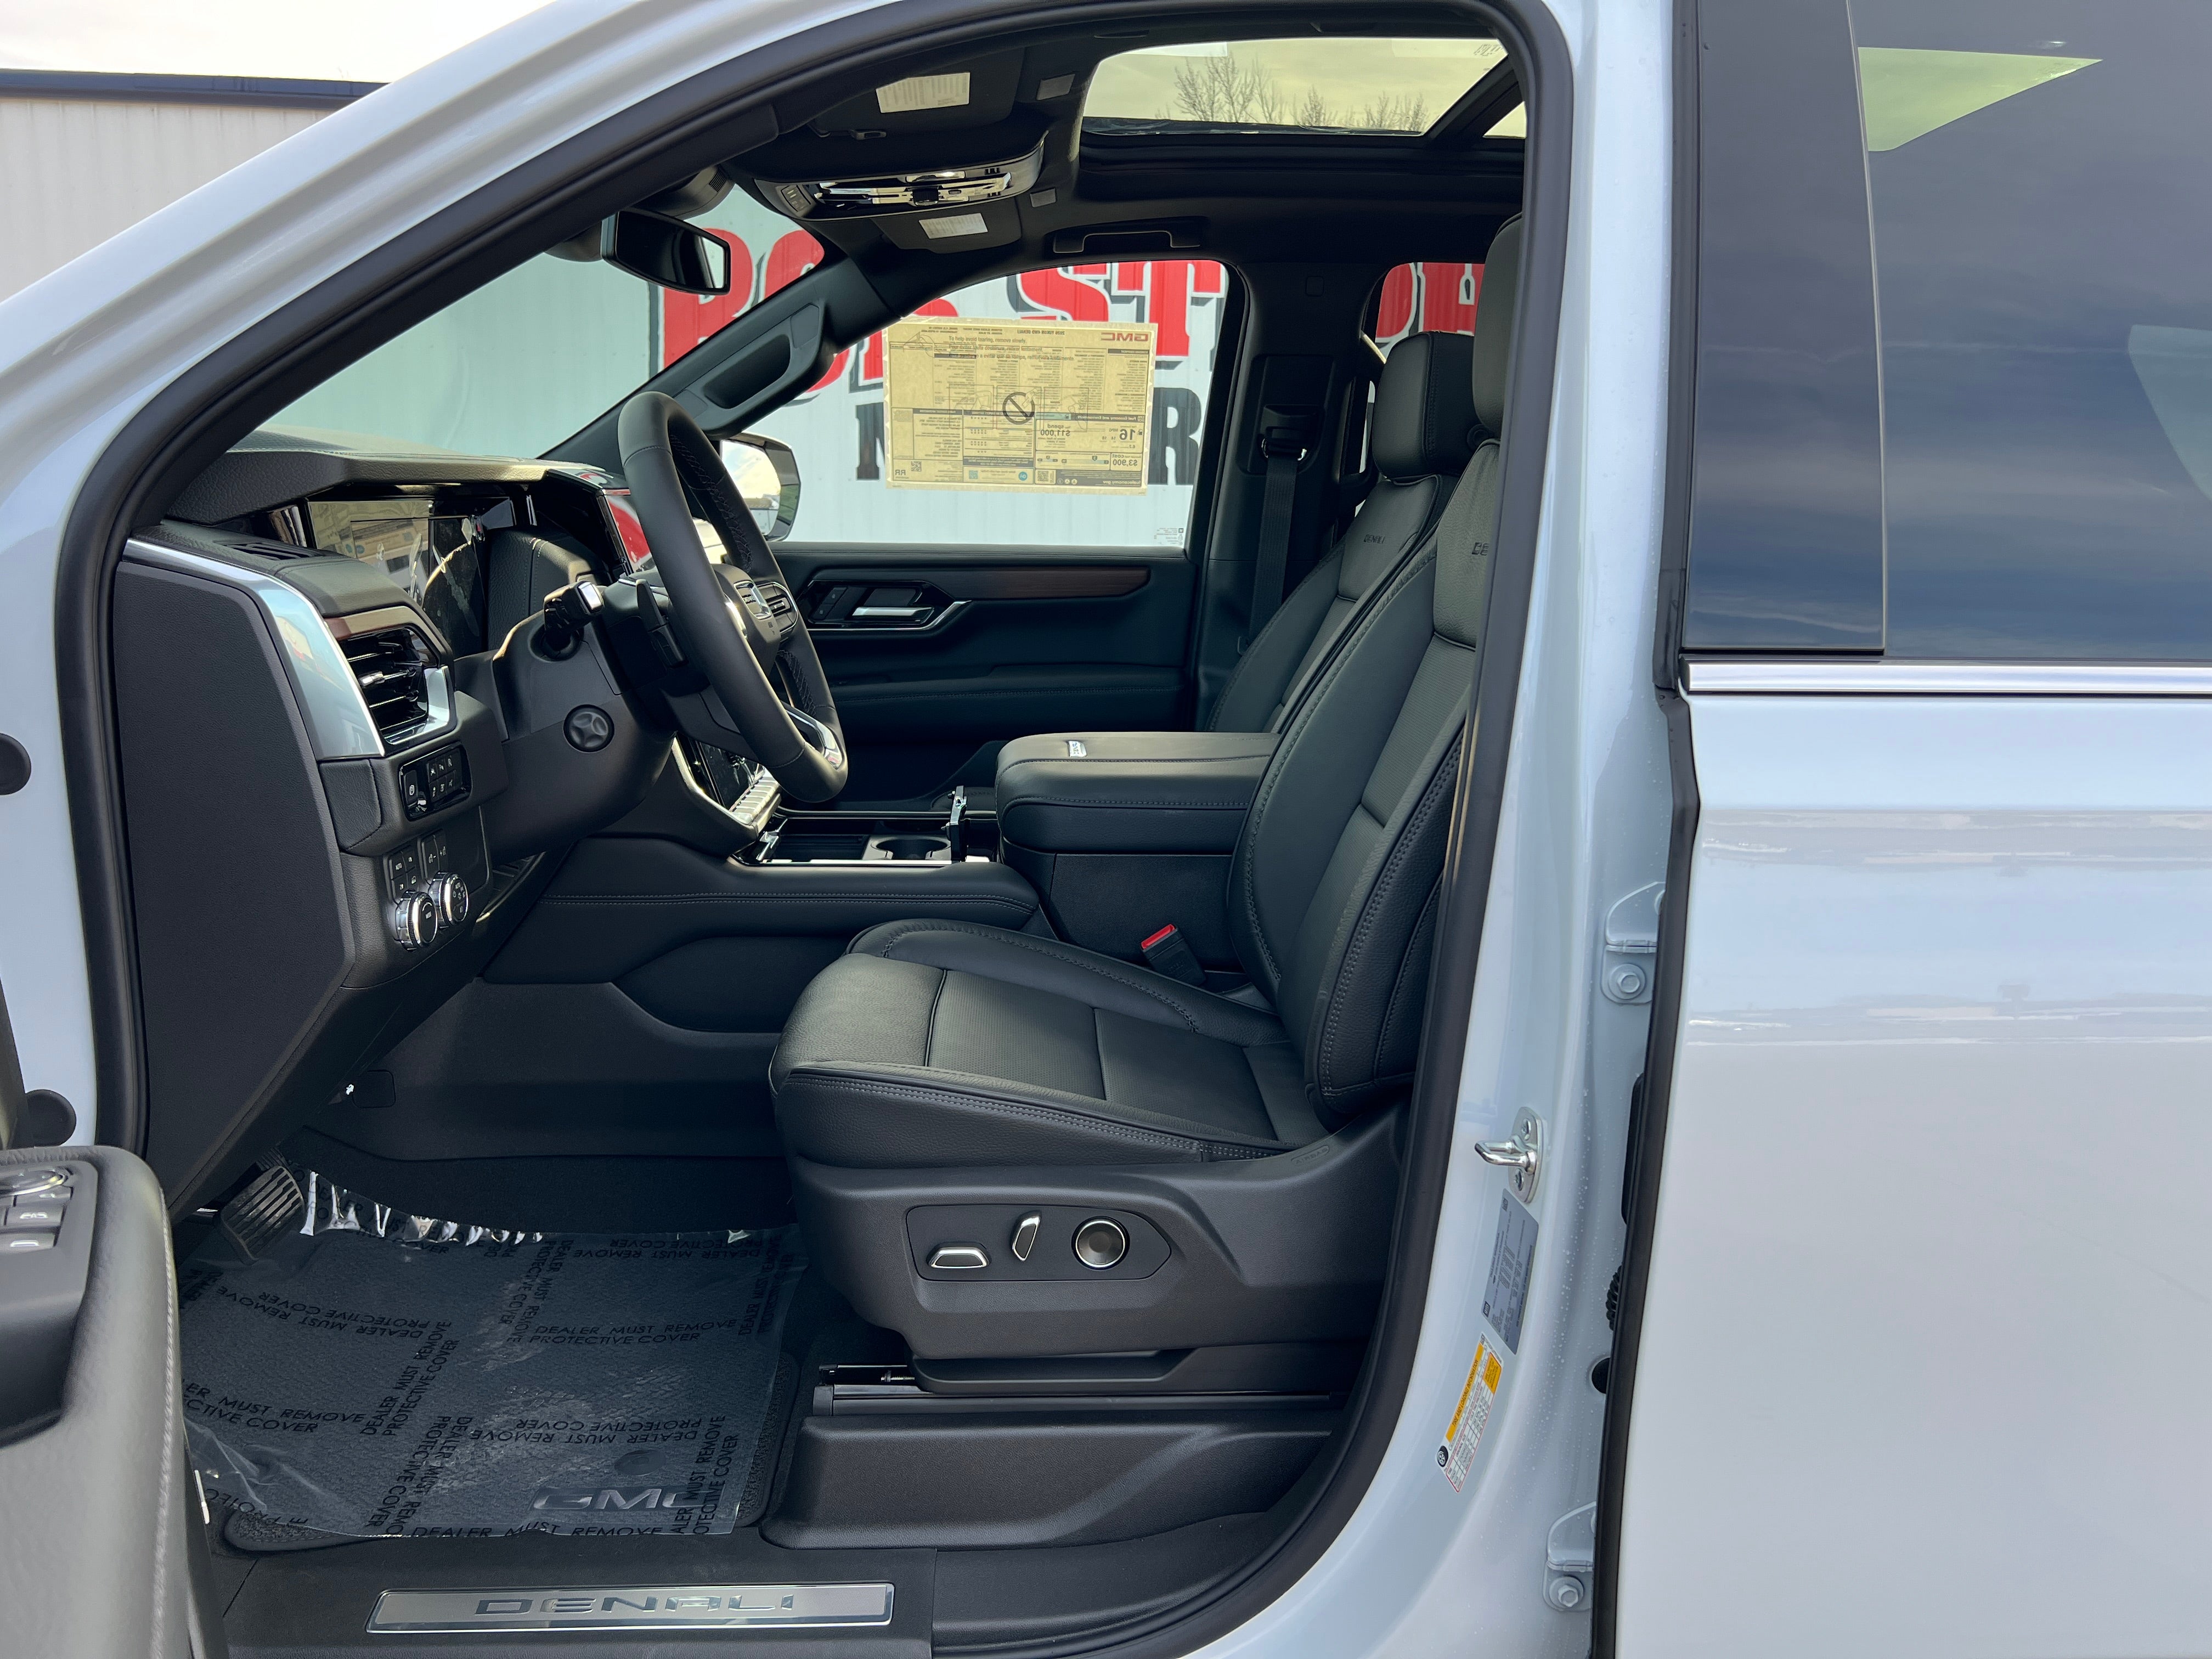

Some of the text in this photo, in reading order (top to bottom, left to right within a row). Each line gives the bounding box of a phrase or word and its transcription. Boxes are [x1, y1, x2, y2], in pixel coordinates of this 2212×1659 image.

[1363, 534, 1385, 544] DENALI
[573, 1249, 642, 1260] REMOVE
[651, 1249, 692, 1260] MUST
[218, 1285, 424, 1339] DEALER MUST REMOVE
[258, 1291, 431, 1329] PROTECTIVE COVER
[506, 1305, 540, 1343] REMOVE
[534, 1319, 737, 1335] DEALER MUST REMOVE
[529, 1332, 701, 1345] PROTECTIVE COVER
[360, 1321, 453, 1435] DEALER MUST REMOVE
[382, 1338, 461, 1436] PROTECTIVE COVER
[219, 1396, 273, 1415] MUST
[279, 1408, 366, 1425] REMOVE
[245, 1417, 319, 1432] COVER
[435, 1416, 473, 1459] DEALER
[469, 1429, 699, 1444] DEALER MUST REMOVE
[517, 1417, 703, 1432] PROTECTIVE COVER
[694, 1414, 727, 1466] REMOVE
[713, 1433, 740, 1479] COVER
[365, 1485, 407, 1527] COVER
[533, 1487, 724, 1510] GMC
[474, 1594, 795, 1617] DENALI
